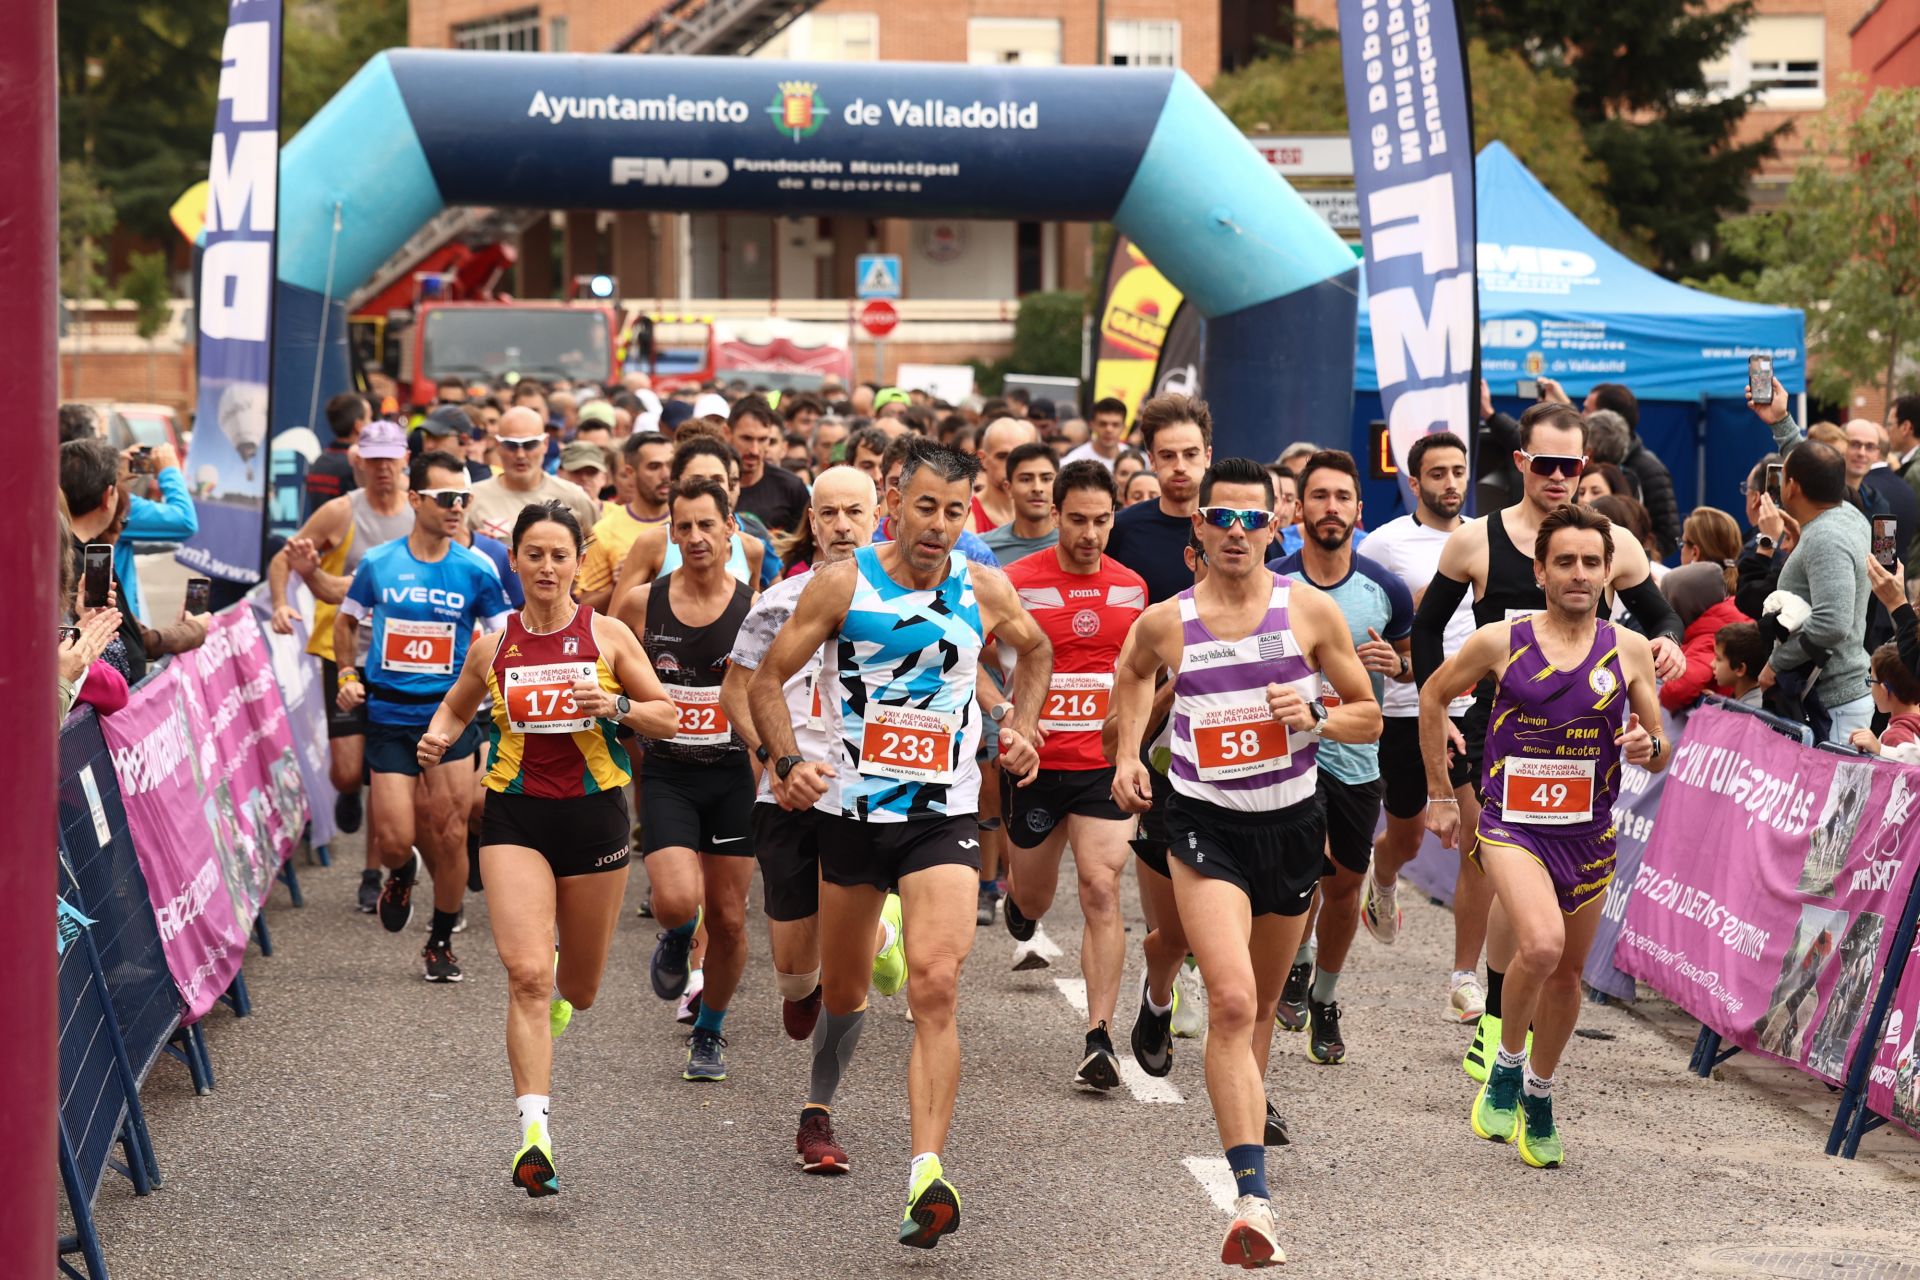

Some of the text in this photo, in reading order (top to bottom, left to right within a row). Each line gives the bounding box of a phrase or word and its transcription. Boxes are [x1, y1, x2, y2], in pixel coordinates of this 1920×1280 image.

[528, 91, 1039, 129] Ayuntamiento de Valladolid
[611, 157, 959, 187] FMD Fundación Municipal
[778, 177, 922, 192] de Deportes
[863, 312, 895, 325] STOP
[382, 586, 465, 609] IVECO
[1259, 634, 1280, 643] RACING
[403, 639, 433, 660] 40
[1190, 648, 1237, 663] Racing Valladolid
[541, 667, 579, 676] MEMORIAL
[525, 688, 578, 716] 173
[1050, 694, 1097, 716] 216
[883, 710, 941, 723] XXIX MEMORIAL
[1224, 705, 1268, 717] MEMORIAL
[1200, 712, 1272, 726] VIDAL-MATARRAN
[1517, 712, 1548, 726] Jamón
[1566, 727, 1600, 739] PRIM
[879, 731, 935, 763] 233
[1220, 729, 1260, 760] 58
[1555, 745, 1601, 757] Macotera
[881, 766, 904, 774] CARRERA
[1242, 763, 1265, 772] POPULAR
[1530, 783, 1568, 807] 49
